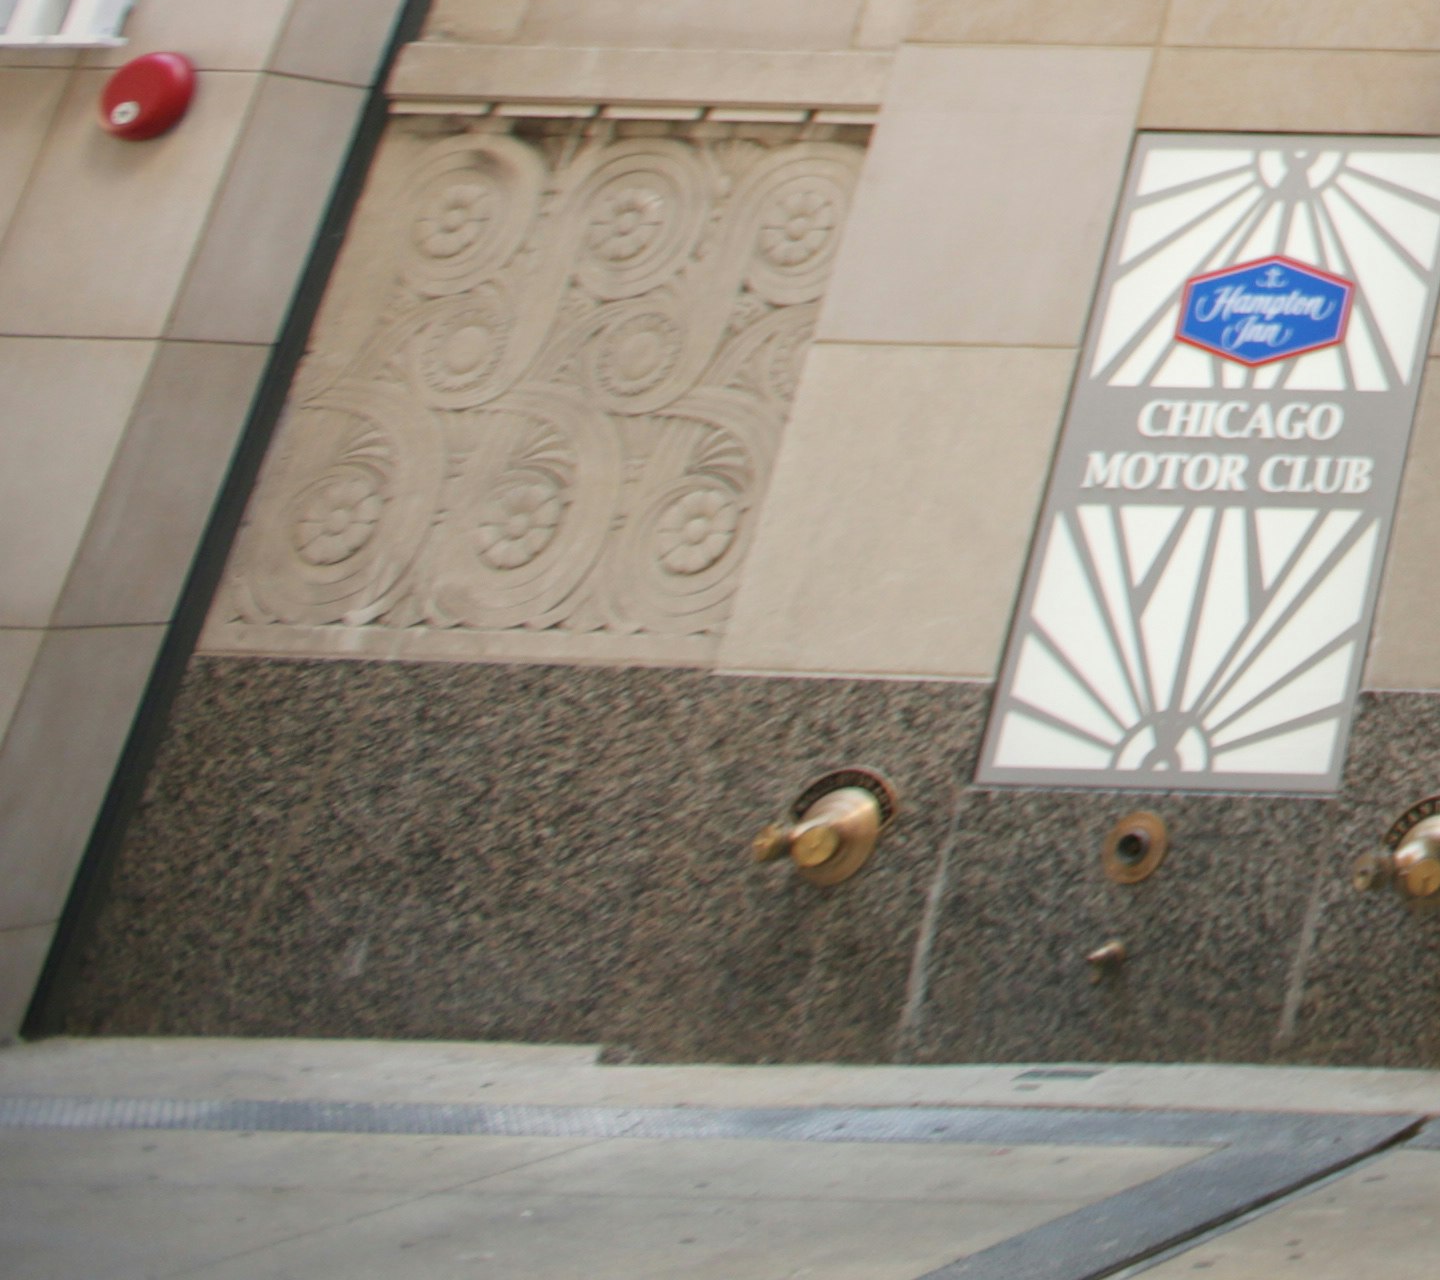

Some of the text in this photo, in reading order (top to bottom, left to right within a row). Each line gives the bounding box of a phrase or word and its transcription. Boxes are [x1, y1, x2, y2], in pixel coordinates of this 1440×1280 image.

[1195, 285, 1337, 322] Hampton
[1221, 315, 1294, 351] Inn
[1137, 399, 1345, 440] CHICAGO
[1080, 451, 1375, 494] MOTOR CLUB
